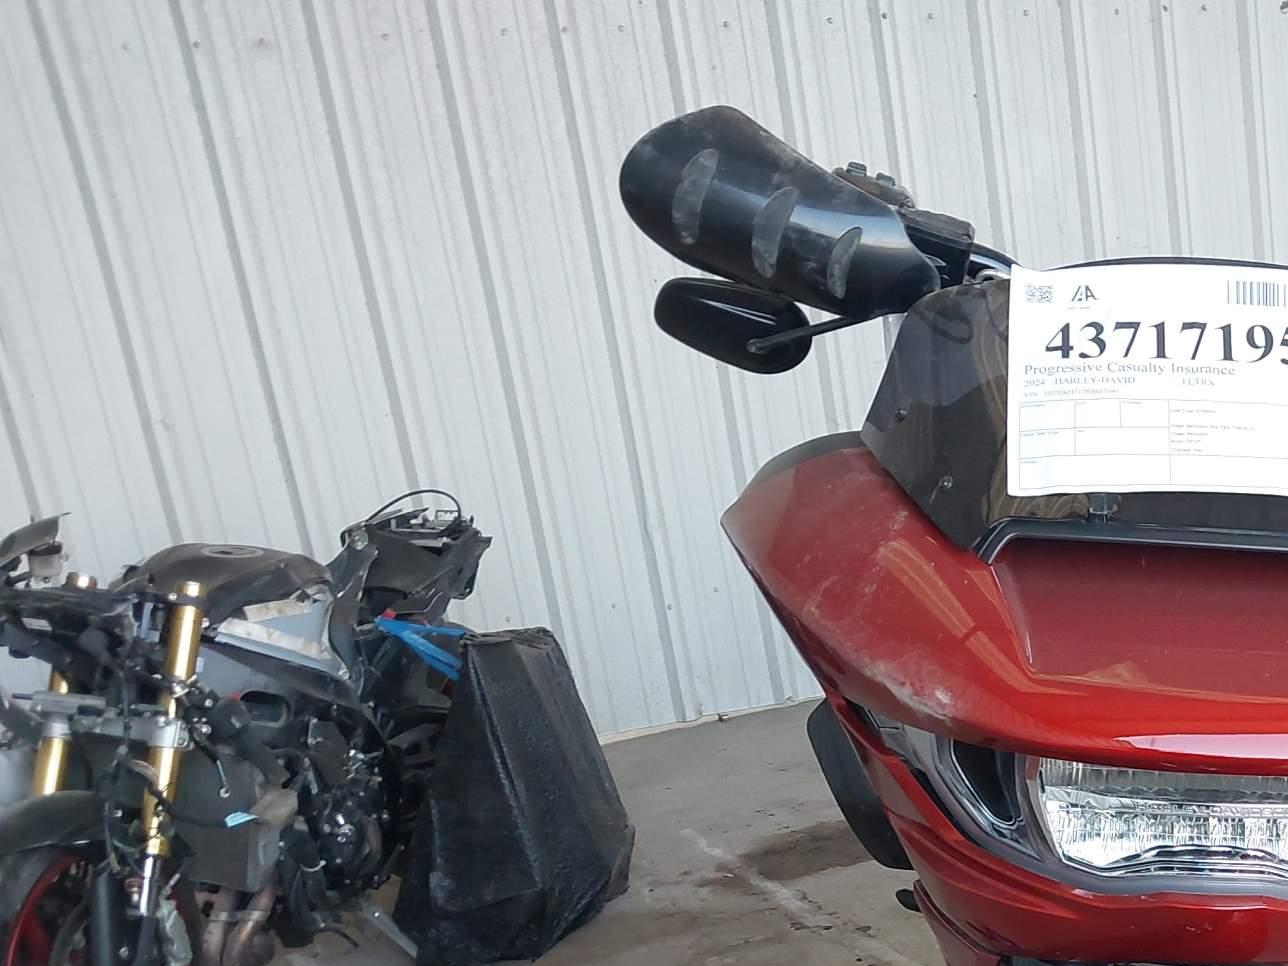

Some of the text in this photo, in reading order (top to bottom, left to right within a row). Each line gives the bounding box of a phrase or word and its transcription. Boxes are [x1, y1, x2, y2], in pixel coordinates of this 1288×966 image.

[1024, 361, 1236, 376] Progressive Casualty Insurance
[1054, 376, 1136, 387] HARLEY-DAVID
